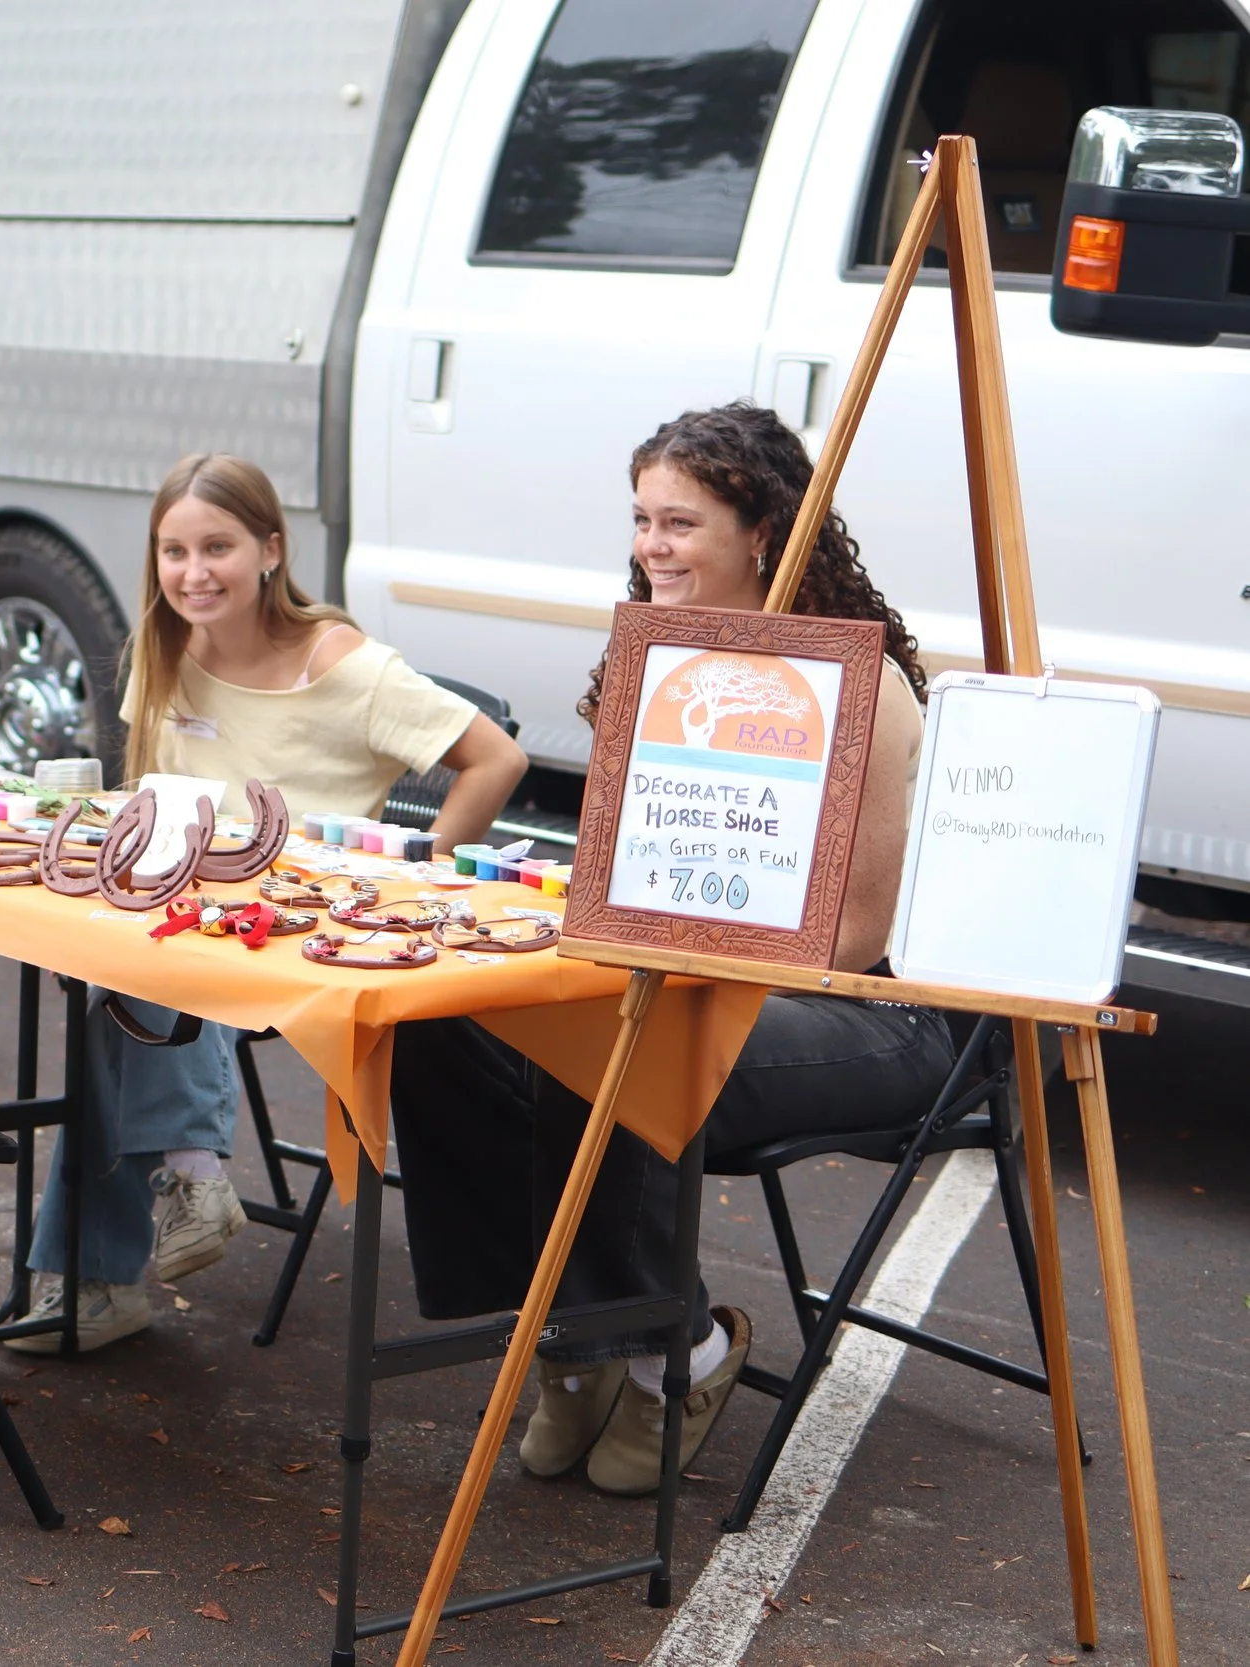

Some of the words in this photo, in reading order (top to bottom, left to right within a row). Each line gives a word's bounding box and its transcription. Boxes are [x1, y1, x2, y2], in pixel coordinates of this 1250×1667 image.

[735, 740, 807, 755] foundation
[738, 723, 808, 747] RAD
[633, 774, 749, 805] DECORATE
[758, 787, 778, 811] A
[947, 765, 1014, 796] VENMO
[646, 803, 718, 830] HORSE
[724, 809, 779, 837] SHOE
[627, 836, 662, 858] FOR
[670, 838, 718, 857] GIFTS
[727, 847, 750, 863] OR
[759, 850, 798, 869] FUN
